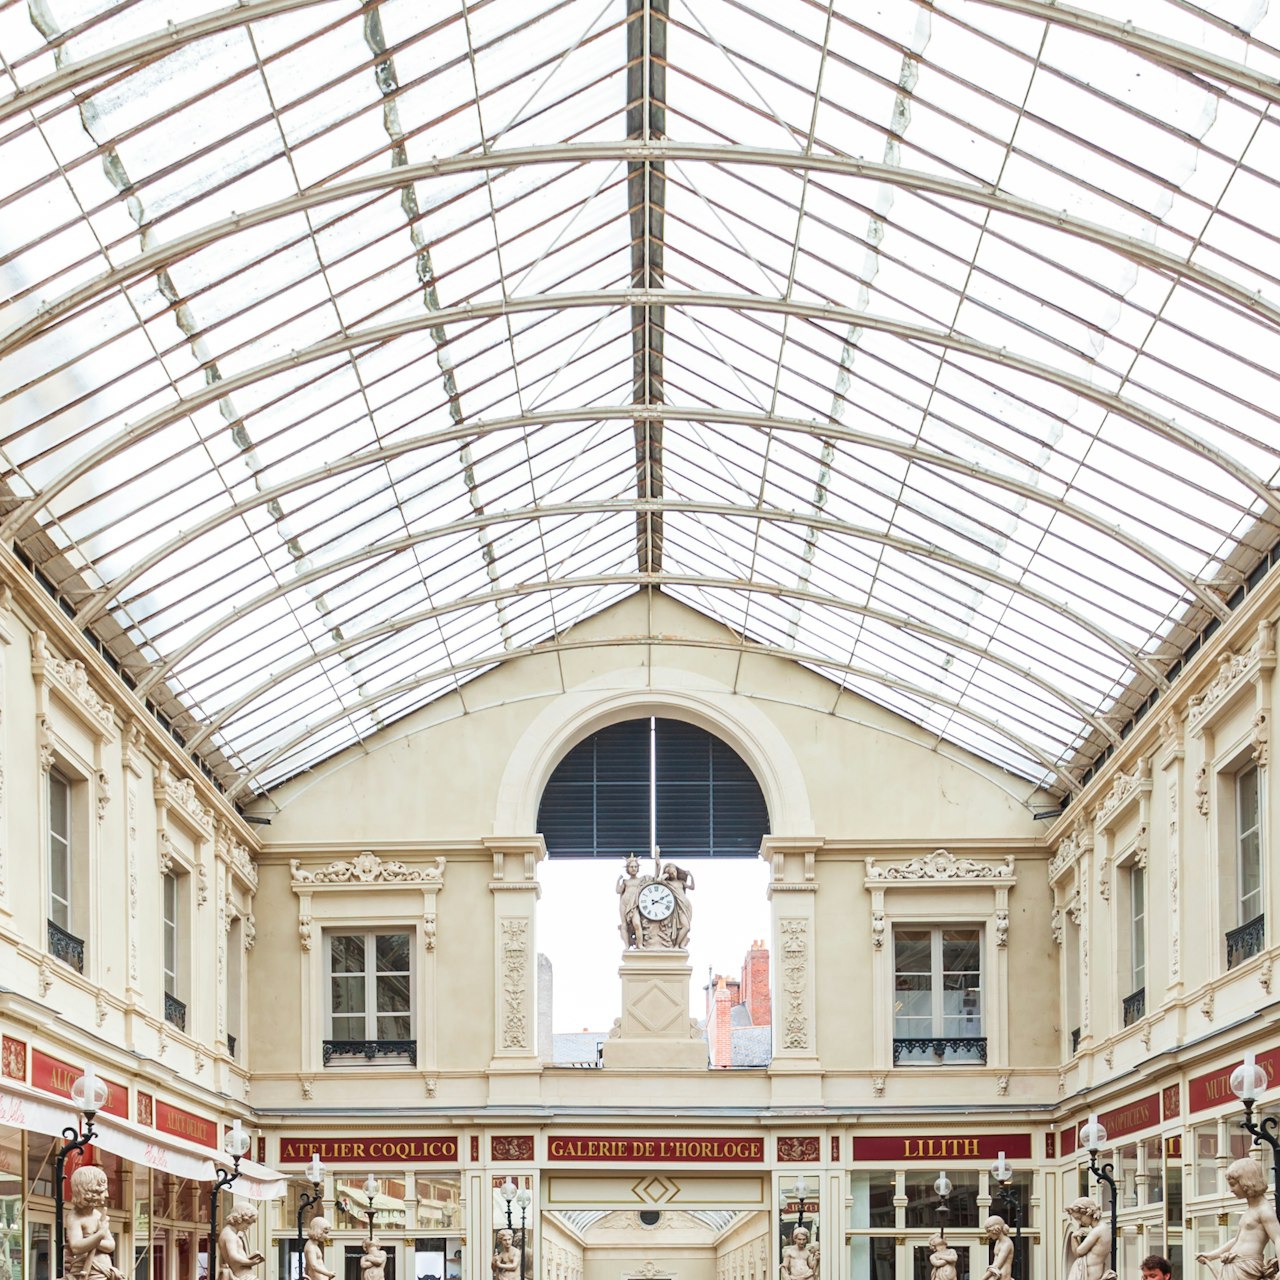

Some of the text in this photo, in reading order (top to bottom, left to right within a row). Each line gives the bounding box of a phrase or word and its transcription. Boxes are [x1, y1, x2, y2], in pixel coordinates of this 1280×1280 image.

[50, 1066, 80, 1094] ALIC
[284, 1142, 456, 1159] ATELIER COQLICO
[551, 1140, 761, 1157] GALERIE DE L'HORLOGE
[904, 1138, 980, 1157] LILITH
